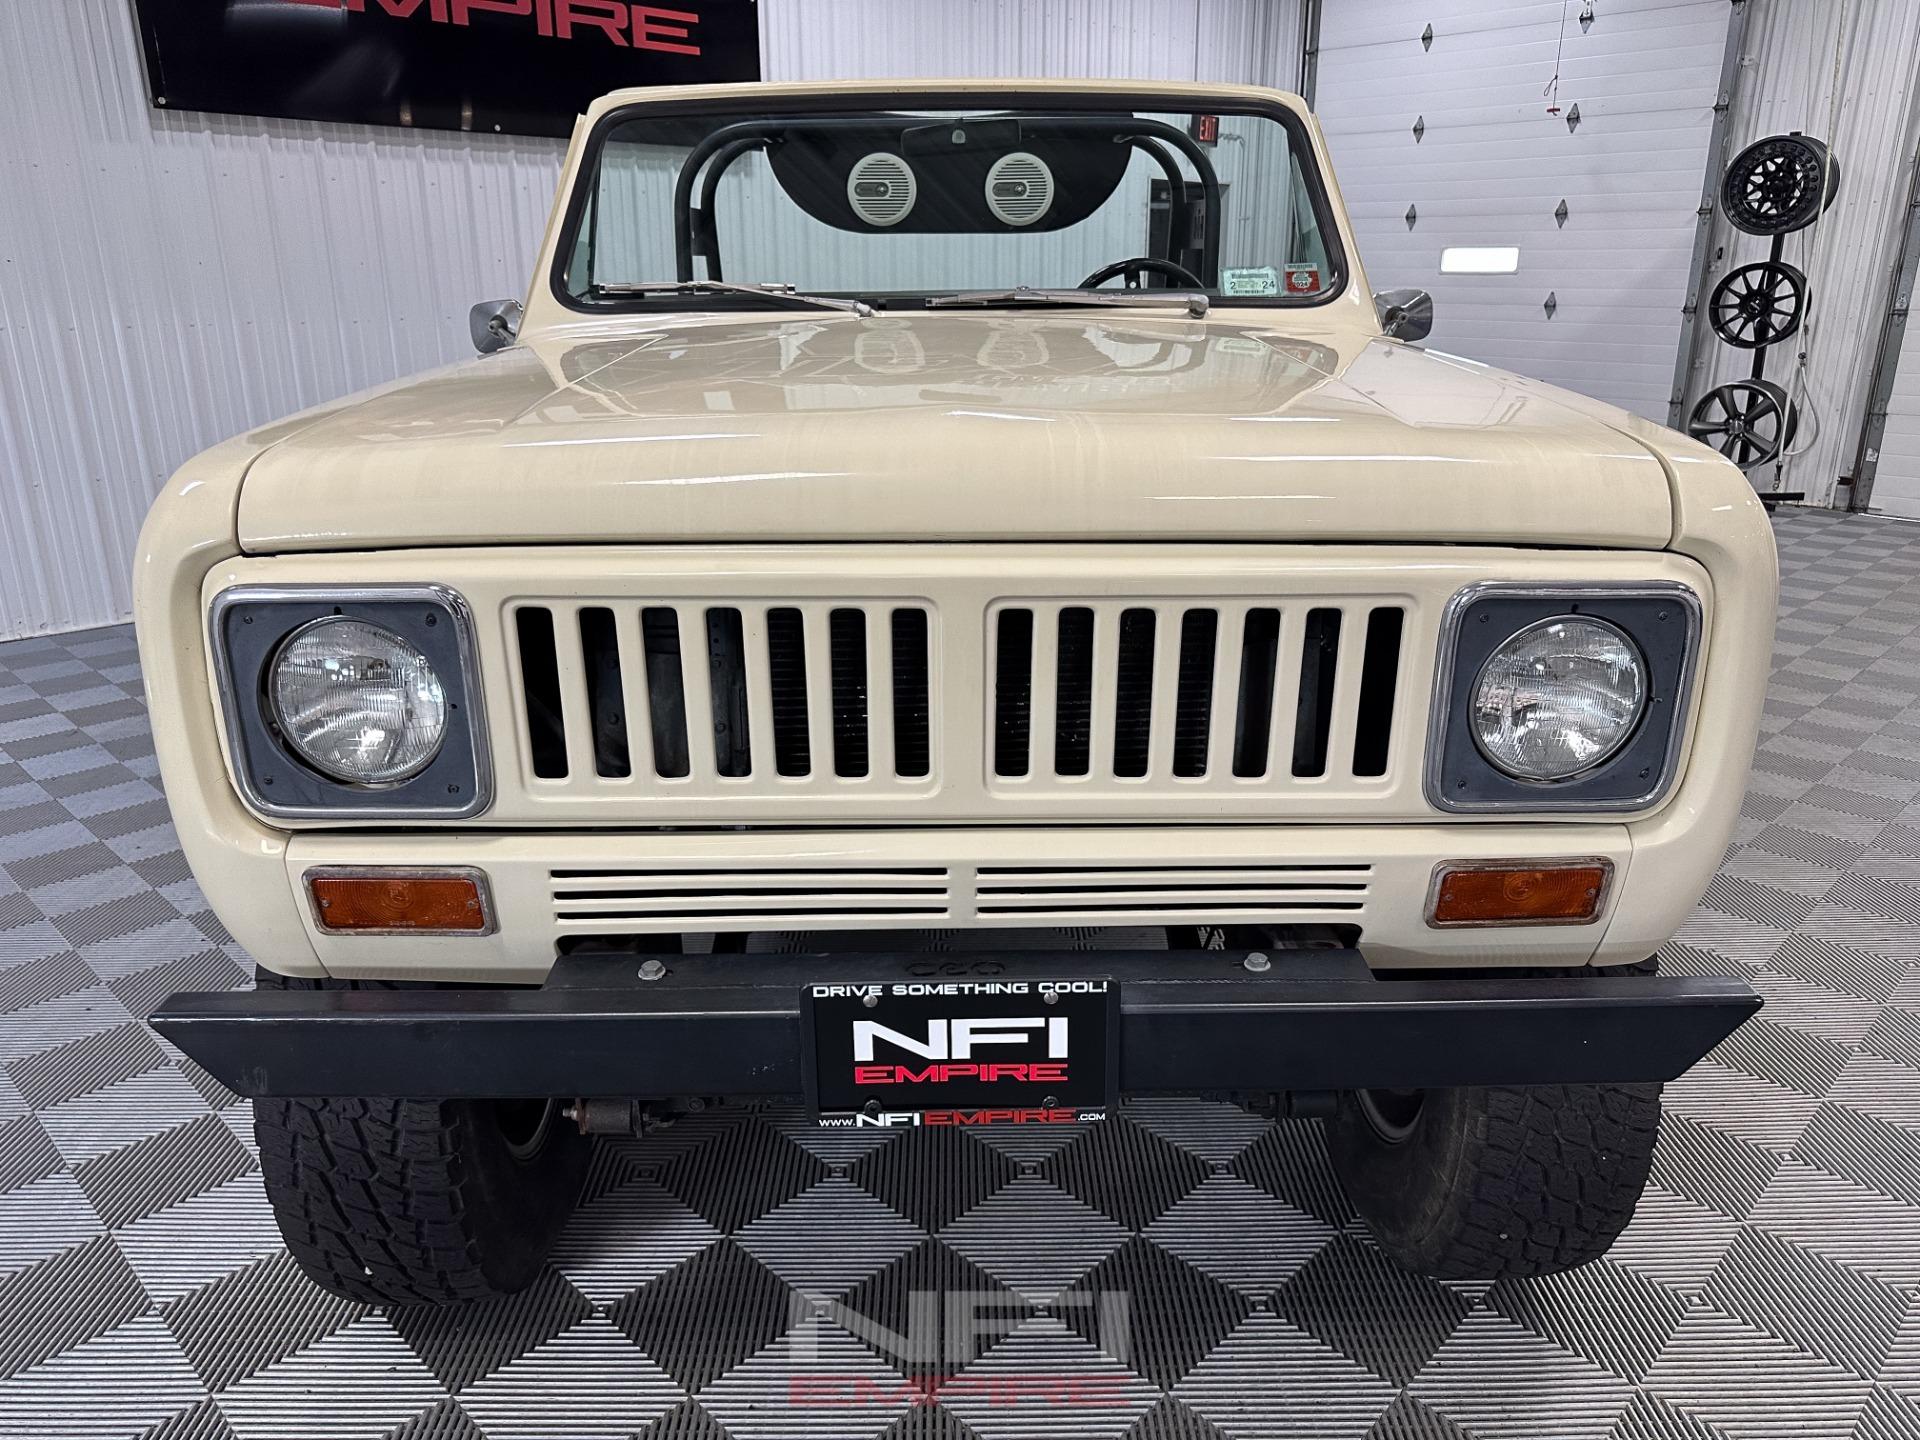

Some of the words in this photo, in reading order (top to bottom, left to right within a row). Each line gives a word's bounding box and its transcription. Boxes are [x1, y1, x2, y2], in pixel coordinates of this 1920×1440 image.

[283, 0, 700, 55] PIRE
[1262, 280, 1275, 289] 24
[812, 985, 883, 997] DRIVE
[892, 982, 1029, 995] SOMETHING
[1038, 981, 1108, 993] COOL!
[853, 1017, 1068, 1061] NFI
[854, 1063, 1068, 1083] EMPIRE
